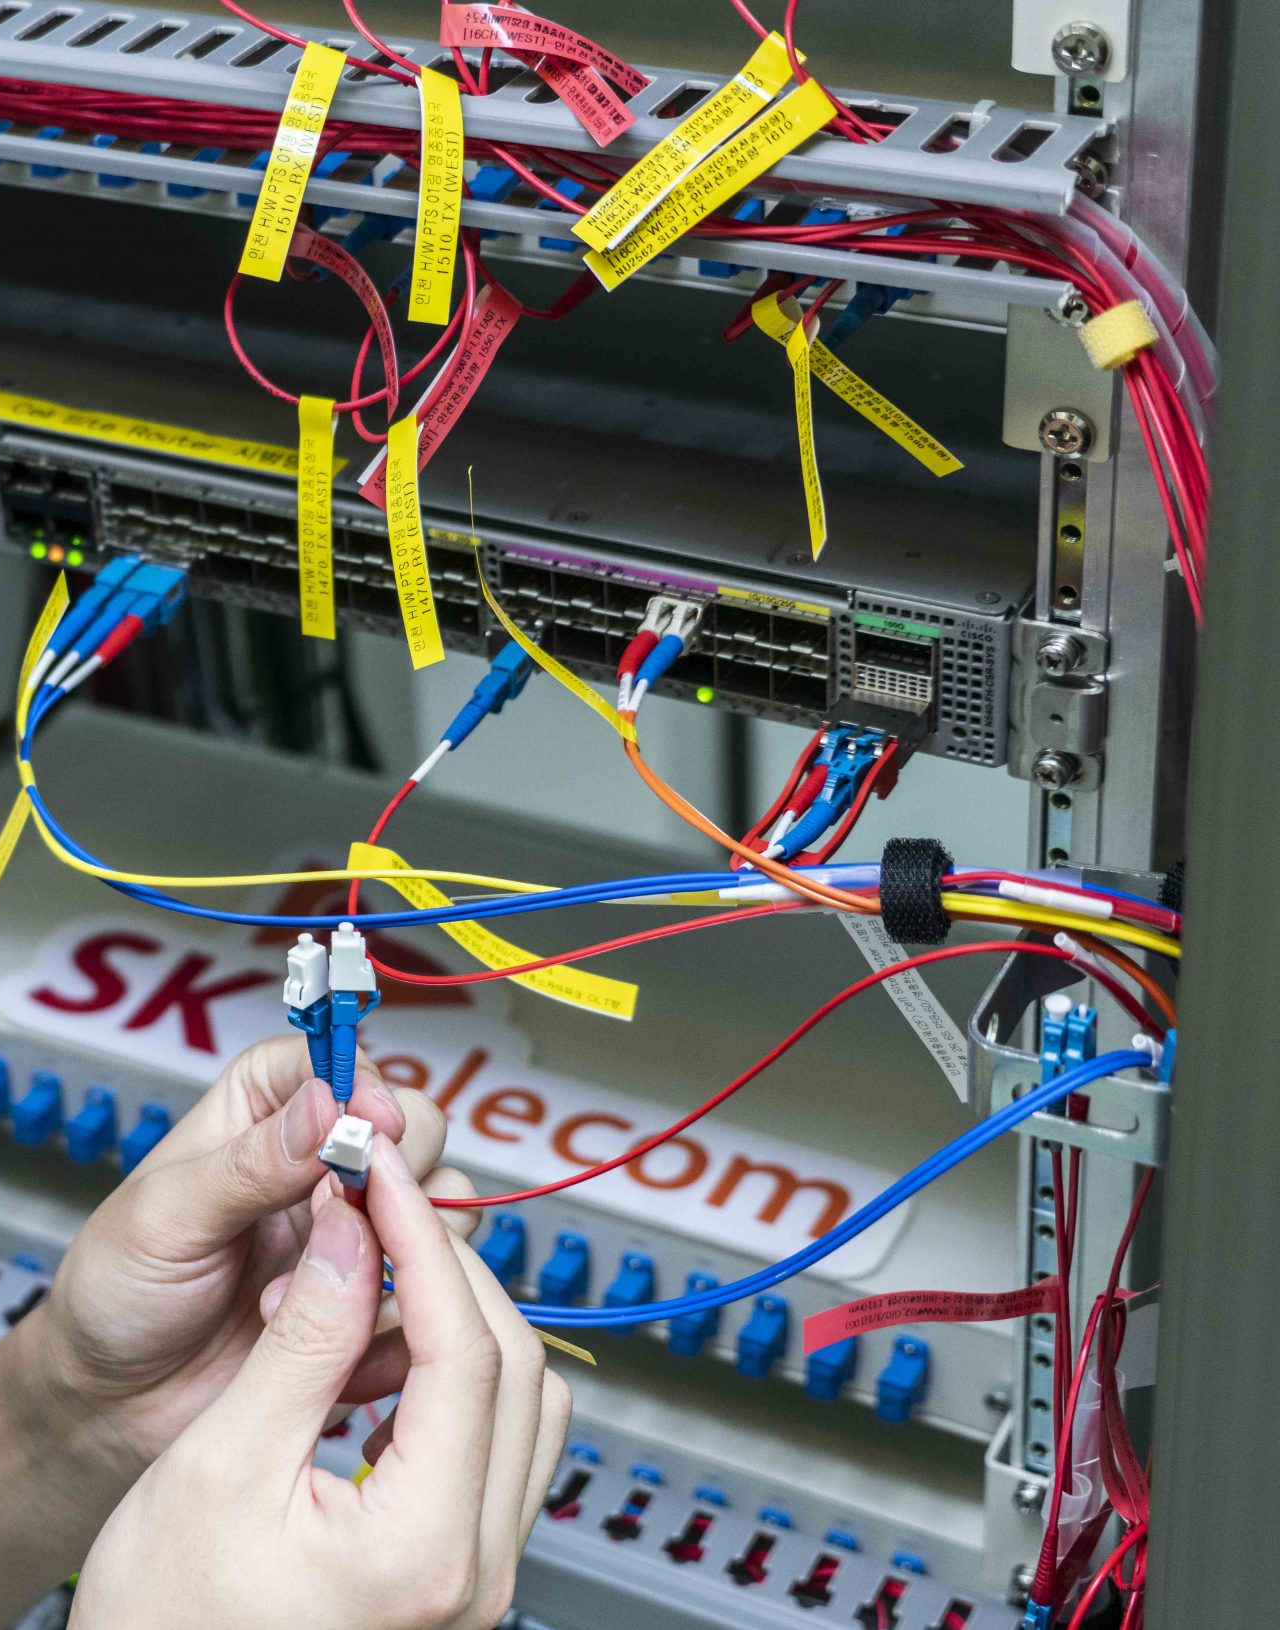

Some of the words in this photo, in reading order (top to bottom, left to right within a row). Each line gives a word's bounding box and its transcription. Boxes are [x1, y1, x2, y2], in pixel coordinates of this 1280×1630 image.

[425, 101, 445, 165] 영종중심국
[273, 159, 308, 234] 1510_RX
[295, 94, 326, 155] (WEST)
[442, 130, 460, 191] (WEST)
[266, 166, 287, 194] PTS
[425, 173, 442, 202] 01링
[257, 197, 277, 228] H/W
[604, 203, 640, 238] NU2562
[673, 158, 688, 172] RX
[423, 208, 438, 234] PTS
[247, 232, 269, 261] 인천
[436, 201, 456, 275] 1510_TX
[614, 242, 655, 277] NU2562
[691, 202, 707, 217] TX
[420, 240, 435, 270] H/W
[414, 278, 431, 304] 인천
[129, 425, 213, 451] Router
[316, 471, 328, 524] (EAST)
[401, 480, 421, 536] (EAST)
[303, 541, 314, 563] PTS
[317, 532, 329, 595] 1470_TX
[303, 568, 314, 592] H/W
[397, 560, 413, 586] PTS
[409, 543, 431, 614] 1470_RX
[403, 591, 418, 619] H/W
[410, 624, 426, 651] 인천
[883, 620, 905, 631] 100G
[866, 944, 887, 971] outer
[29, 931, 285, 1055] SK
[897, 993, 916, 1014] Cell
[360, 1030, 852, 1239] elecom
